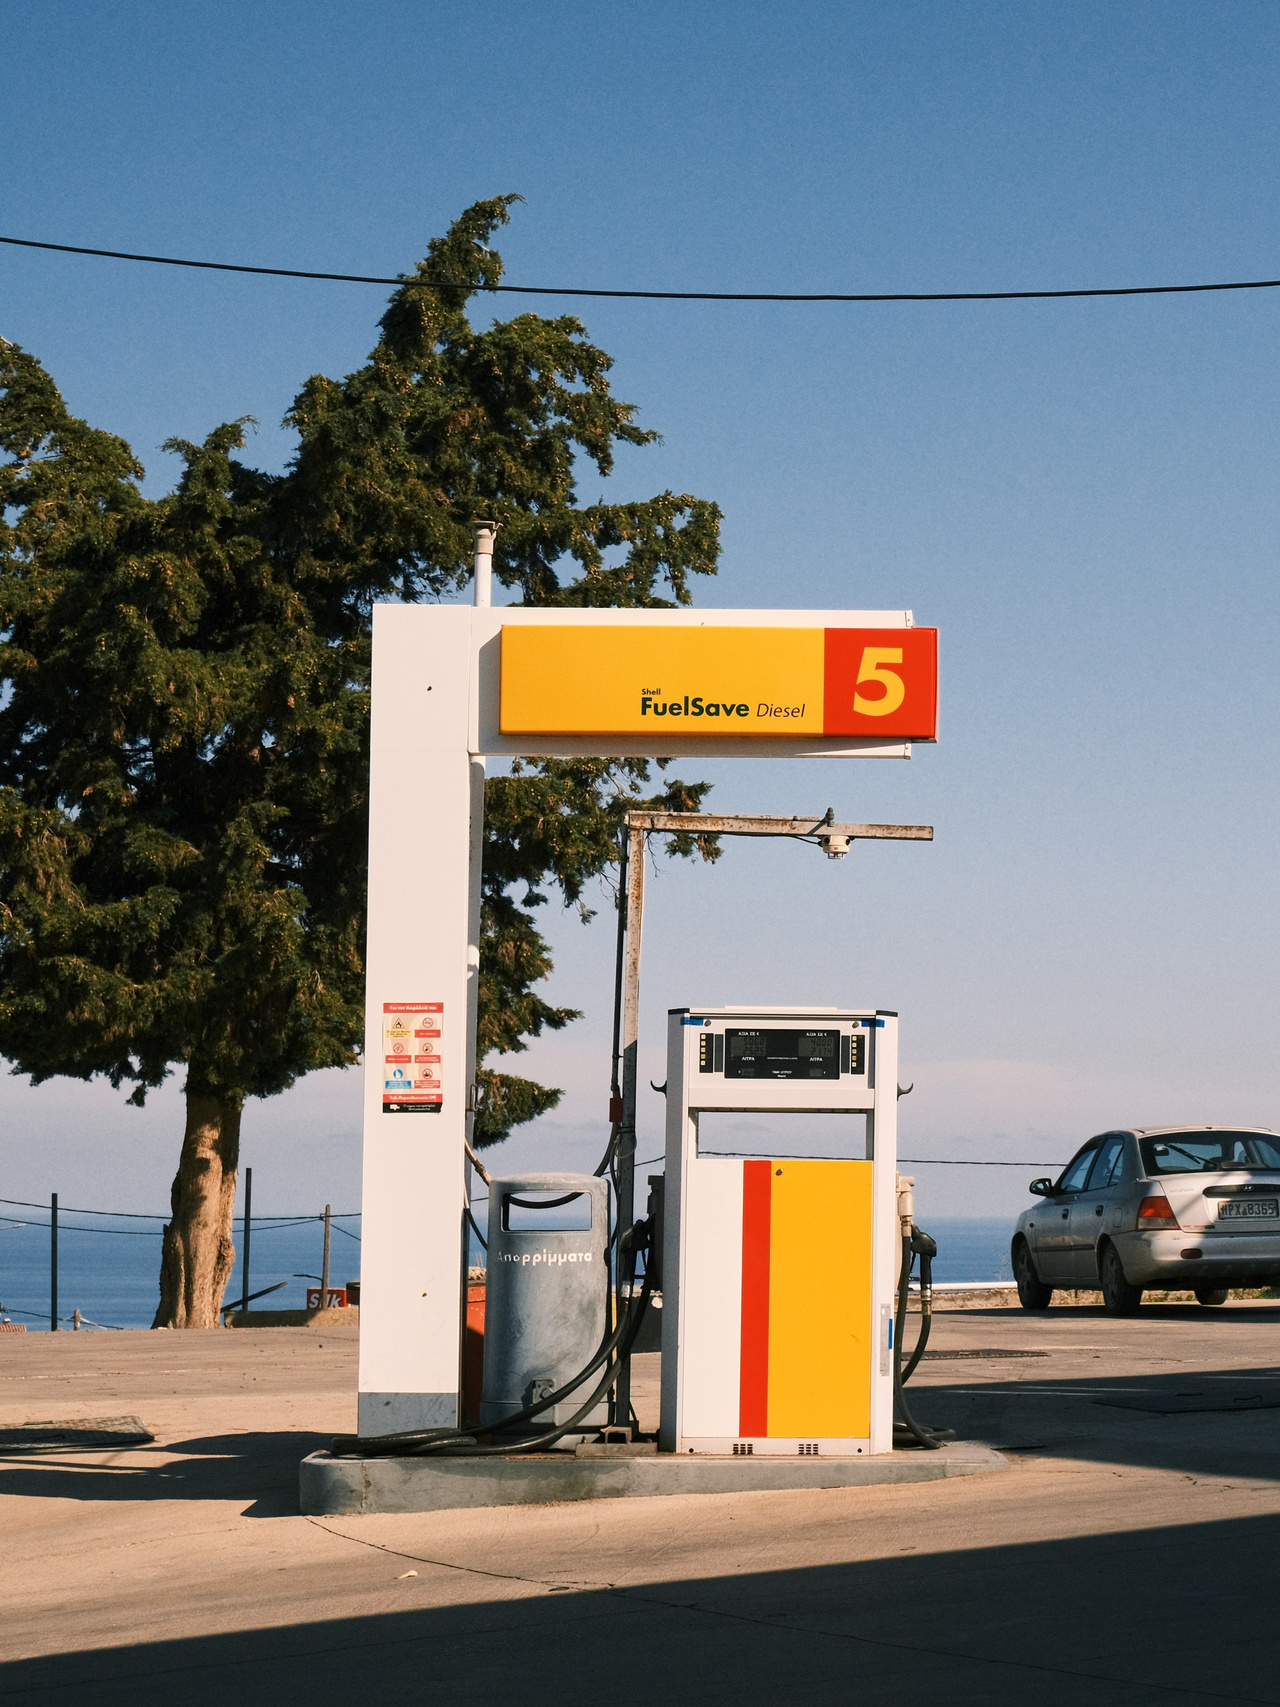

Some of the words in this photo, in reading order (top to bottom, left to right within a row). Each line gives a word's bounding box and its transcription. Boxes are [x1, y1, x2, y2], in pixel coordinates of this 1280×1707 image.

[853, 647, 905, 717] 5
[641, 688, 661, 696] Shell
[641, 695, 750, 718] FuelSave
[756, 703, 806, 718] Diesel
[1247, 1203, 1275, 1216] 8365
[308, 1293, 342, 1309] Slk
